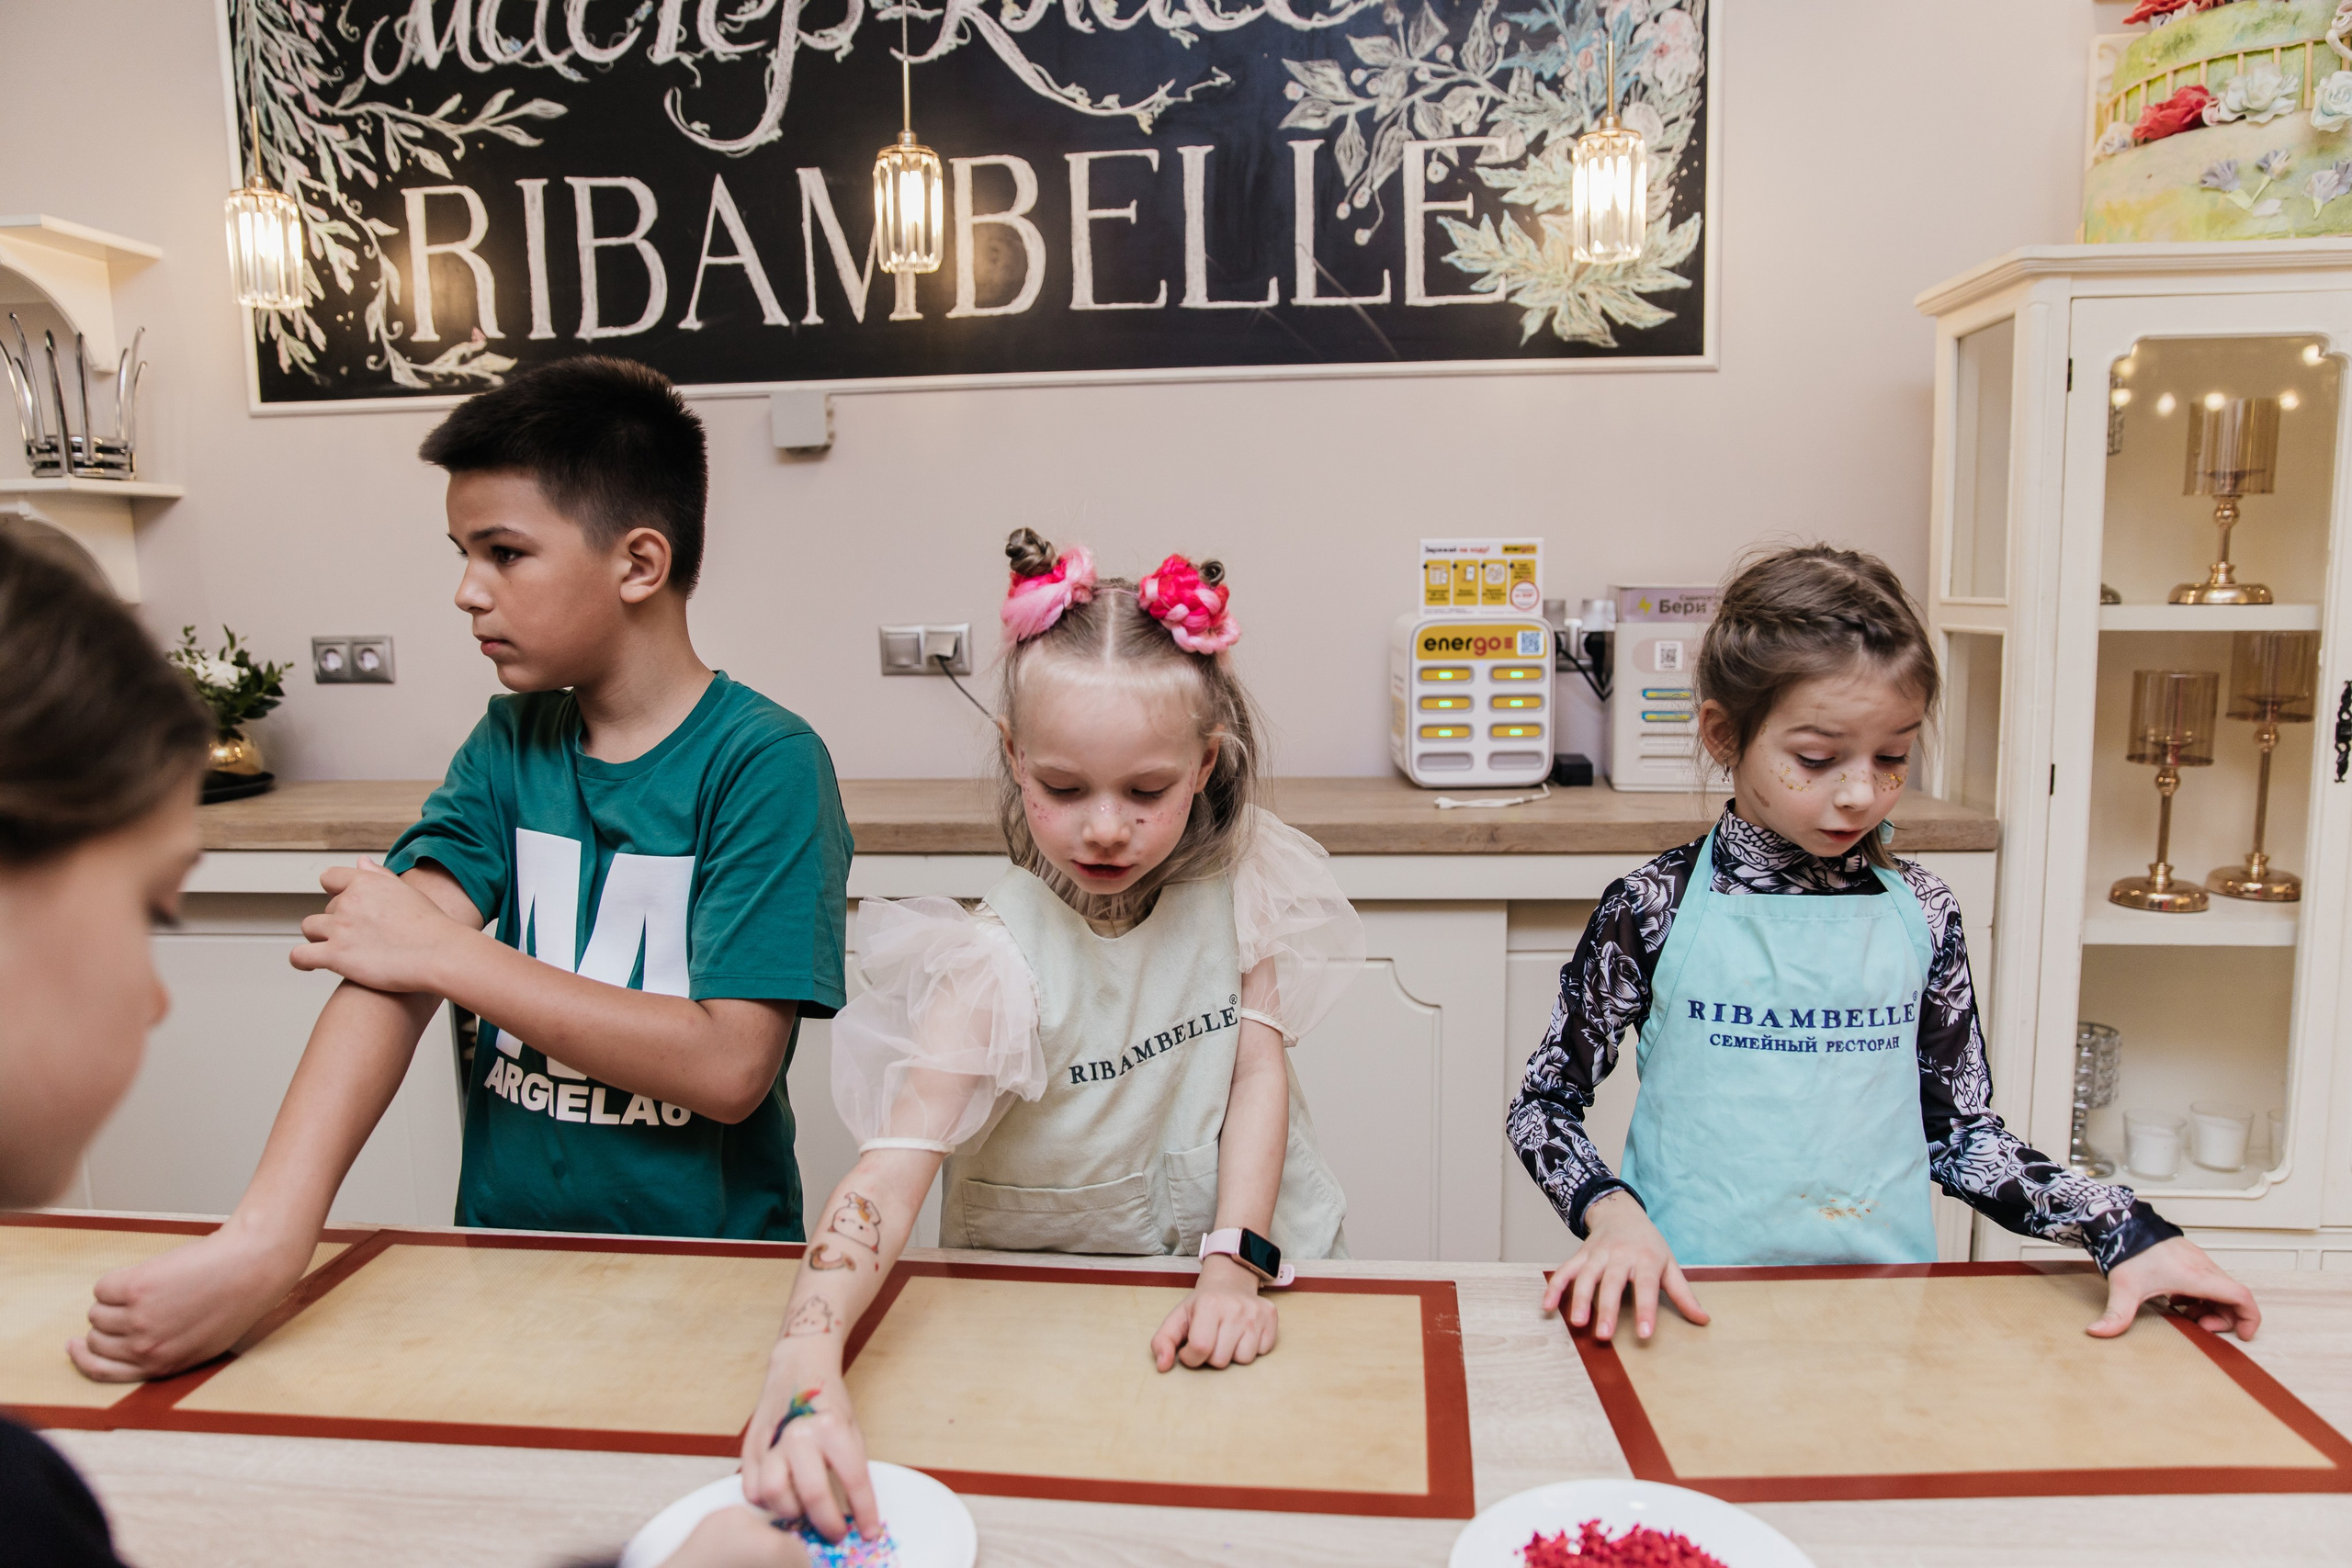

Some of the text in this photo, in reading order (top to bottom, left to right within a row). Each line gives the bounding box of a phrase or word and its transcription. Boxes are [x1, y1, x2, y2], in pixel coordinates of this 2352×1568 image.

[401, 137, 1509, 343] RIBAMBELLE
[1659, 599, 1707, 615] Бери
[1424, 637, 1501, 657] energo
[1710, 1033, 1901, 1054] СЕМЕЙНЫЙ РЕСТОРАН
